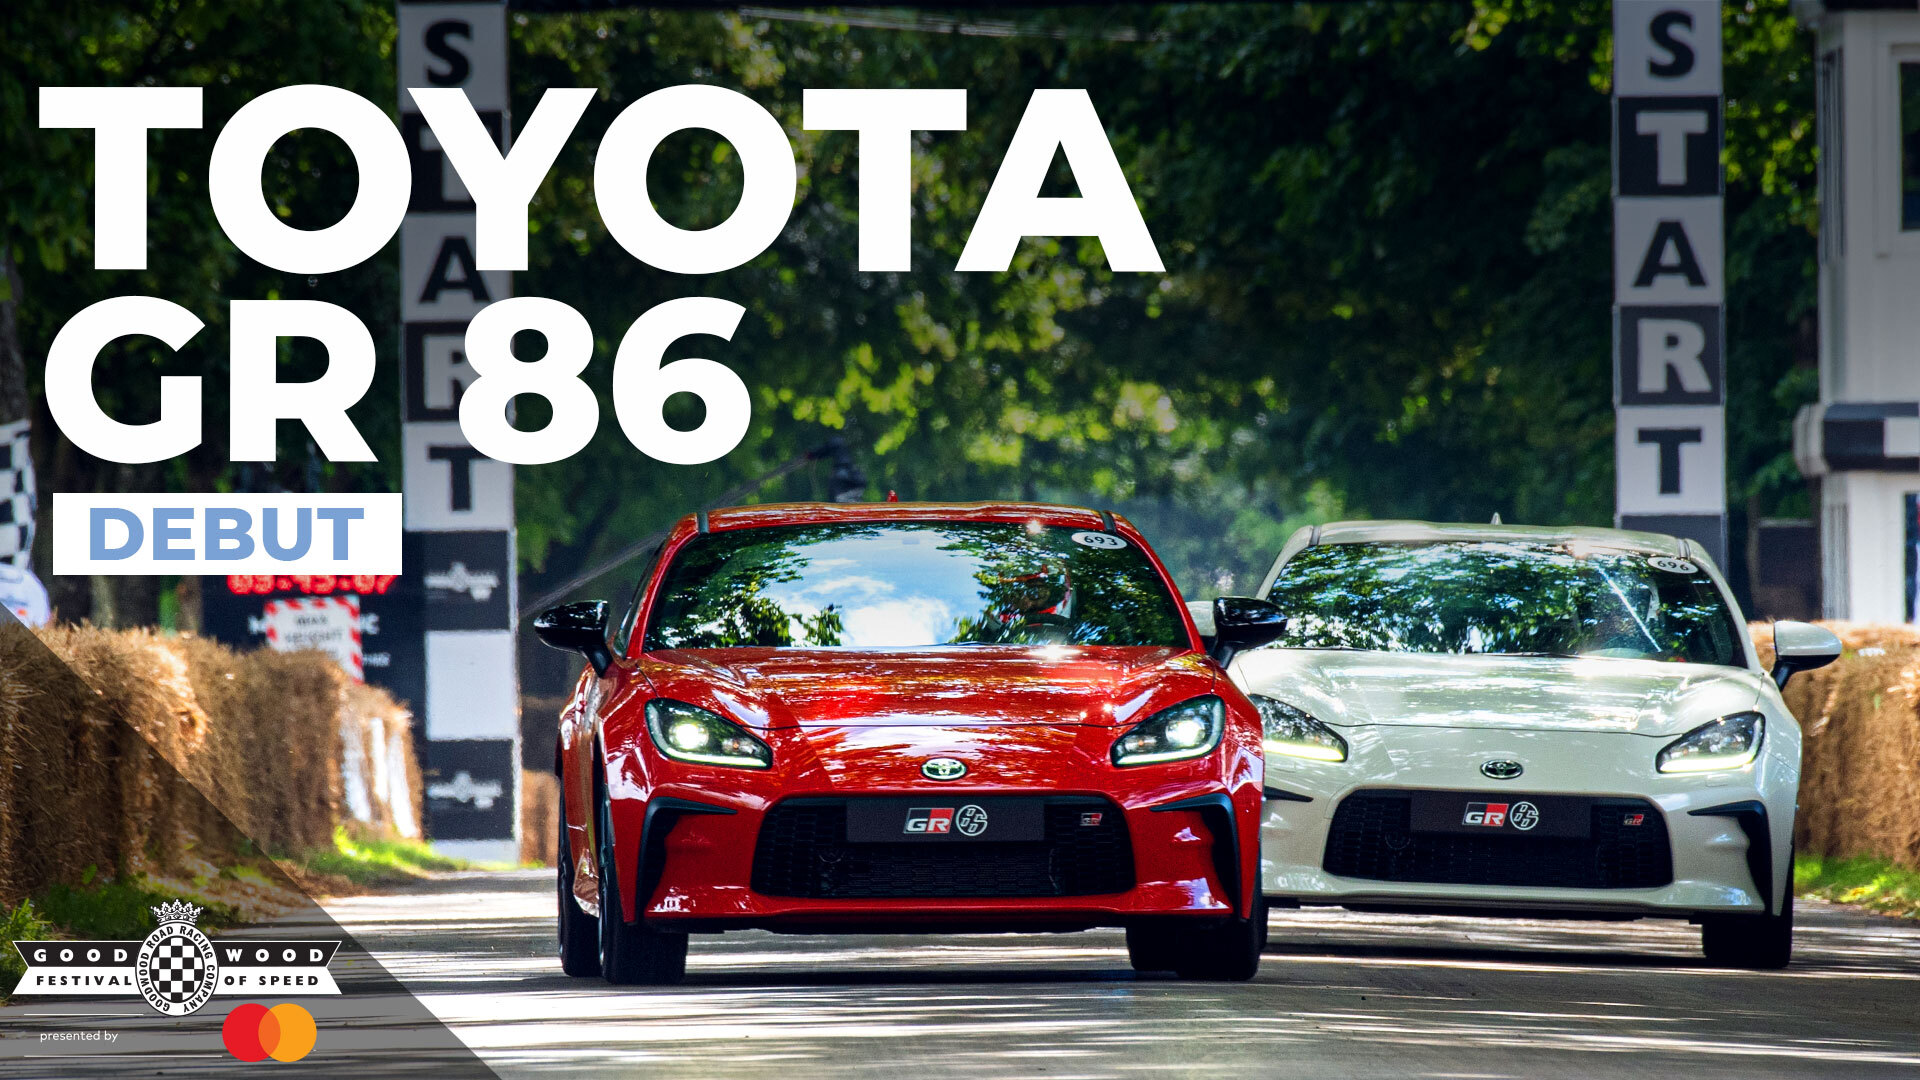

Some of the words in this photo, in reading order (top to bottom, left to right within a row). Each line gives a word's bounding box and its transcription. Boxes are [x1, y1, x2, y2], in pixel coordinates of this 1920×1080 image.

[1633, 9, 1712, 495] START
[1083, 535, 1118, 546] 693
[1657, 560, 1689, 571] 696
[905, 816, 952, 833] GR
[1464, 810, 1505, 826] GR
